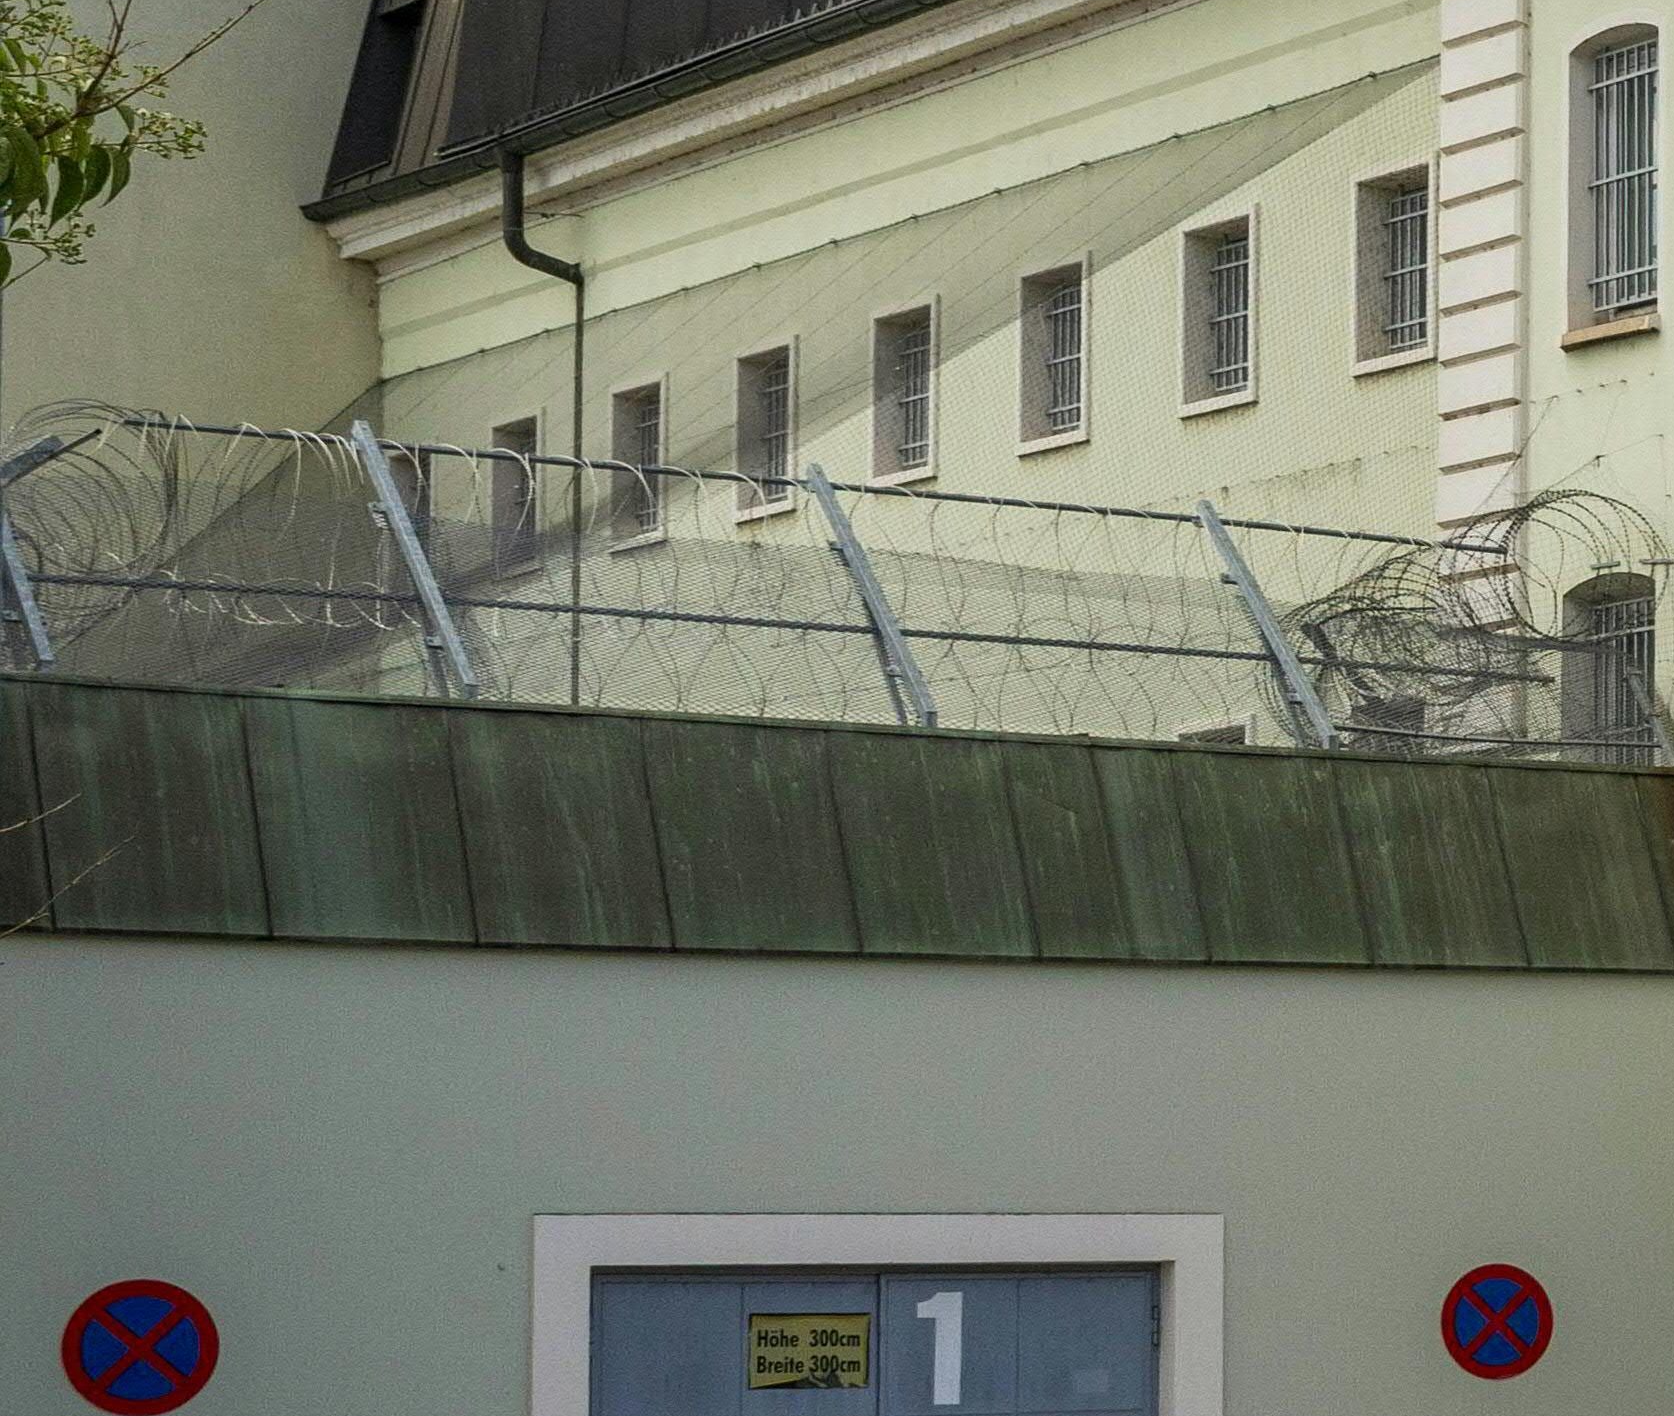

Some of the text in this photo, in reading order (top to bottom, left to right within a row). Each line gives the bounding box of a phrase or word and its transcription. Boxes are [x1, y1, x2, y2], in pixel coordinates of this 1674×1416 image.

[757, 1329, 861, 1347] Höhe 300cm
[917, 1292, 963, 1405] 1
[756, 1355, 861, 1374] Breite 300cm
